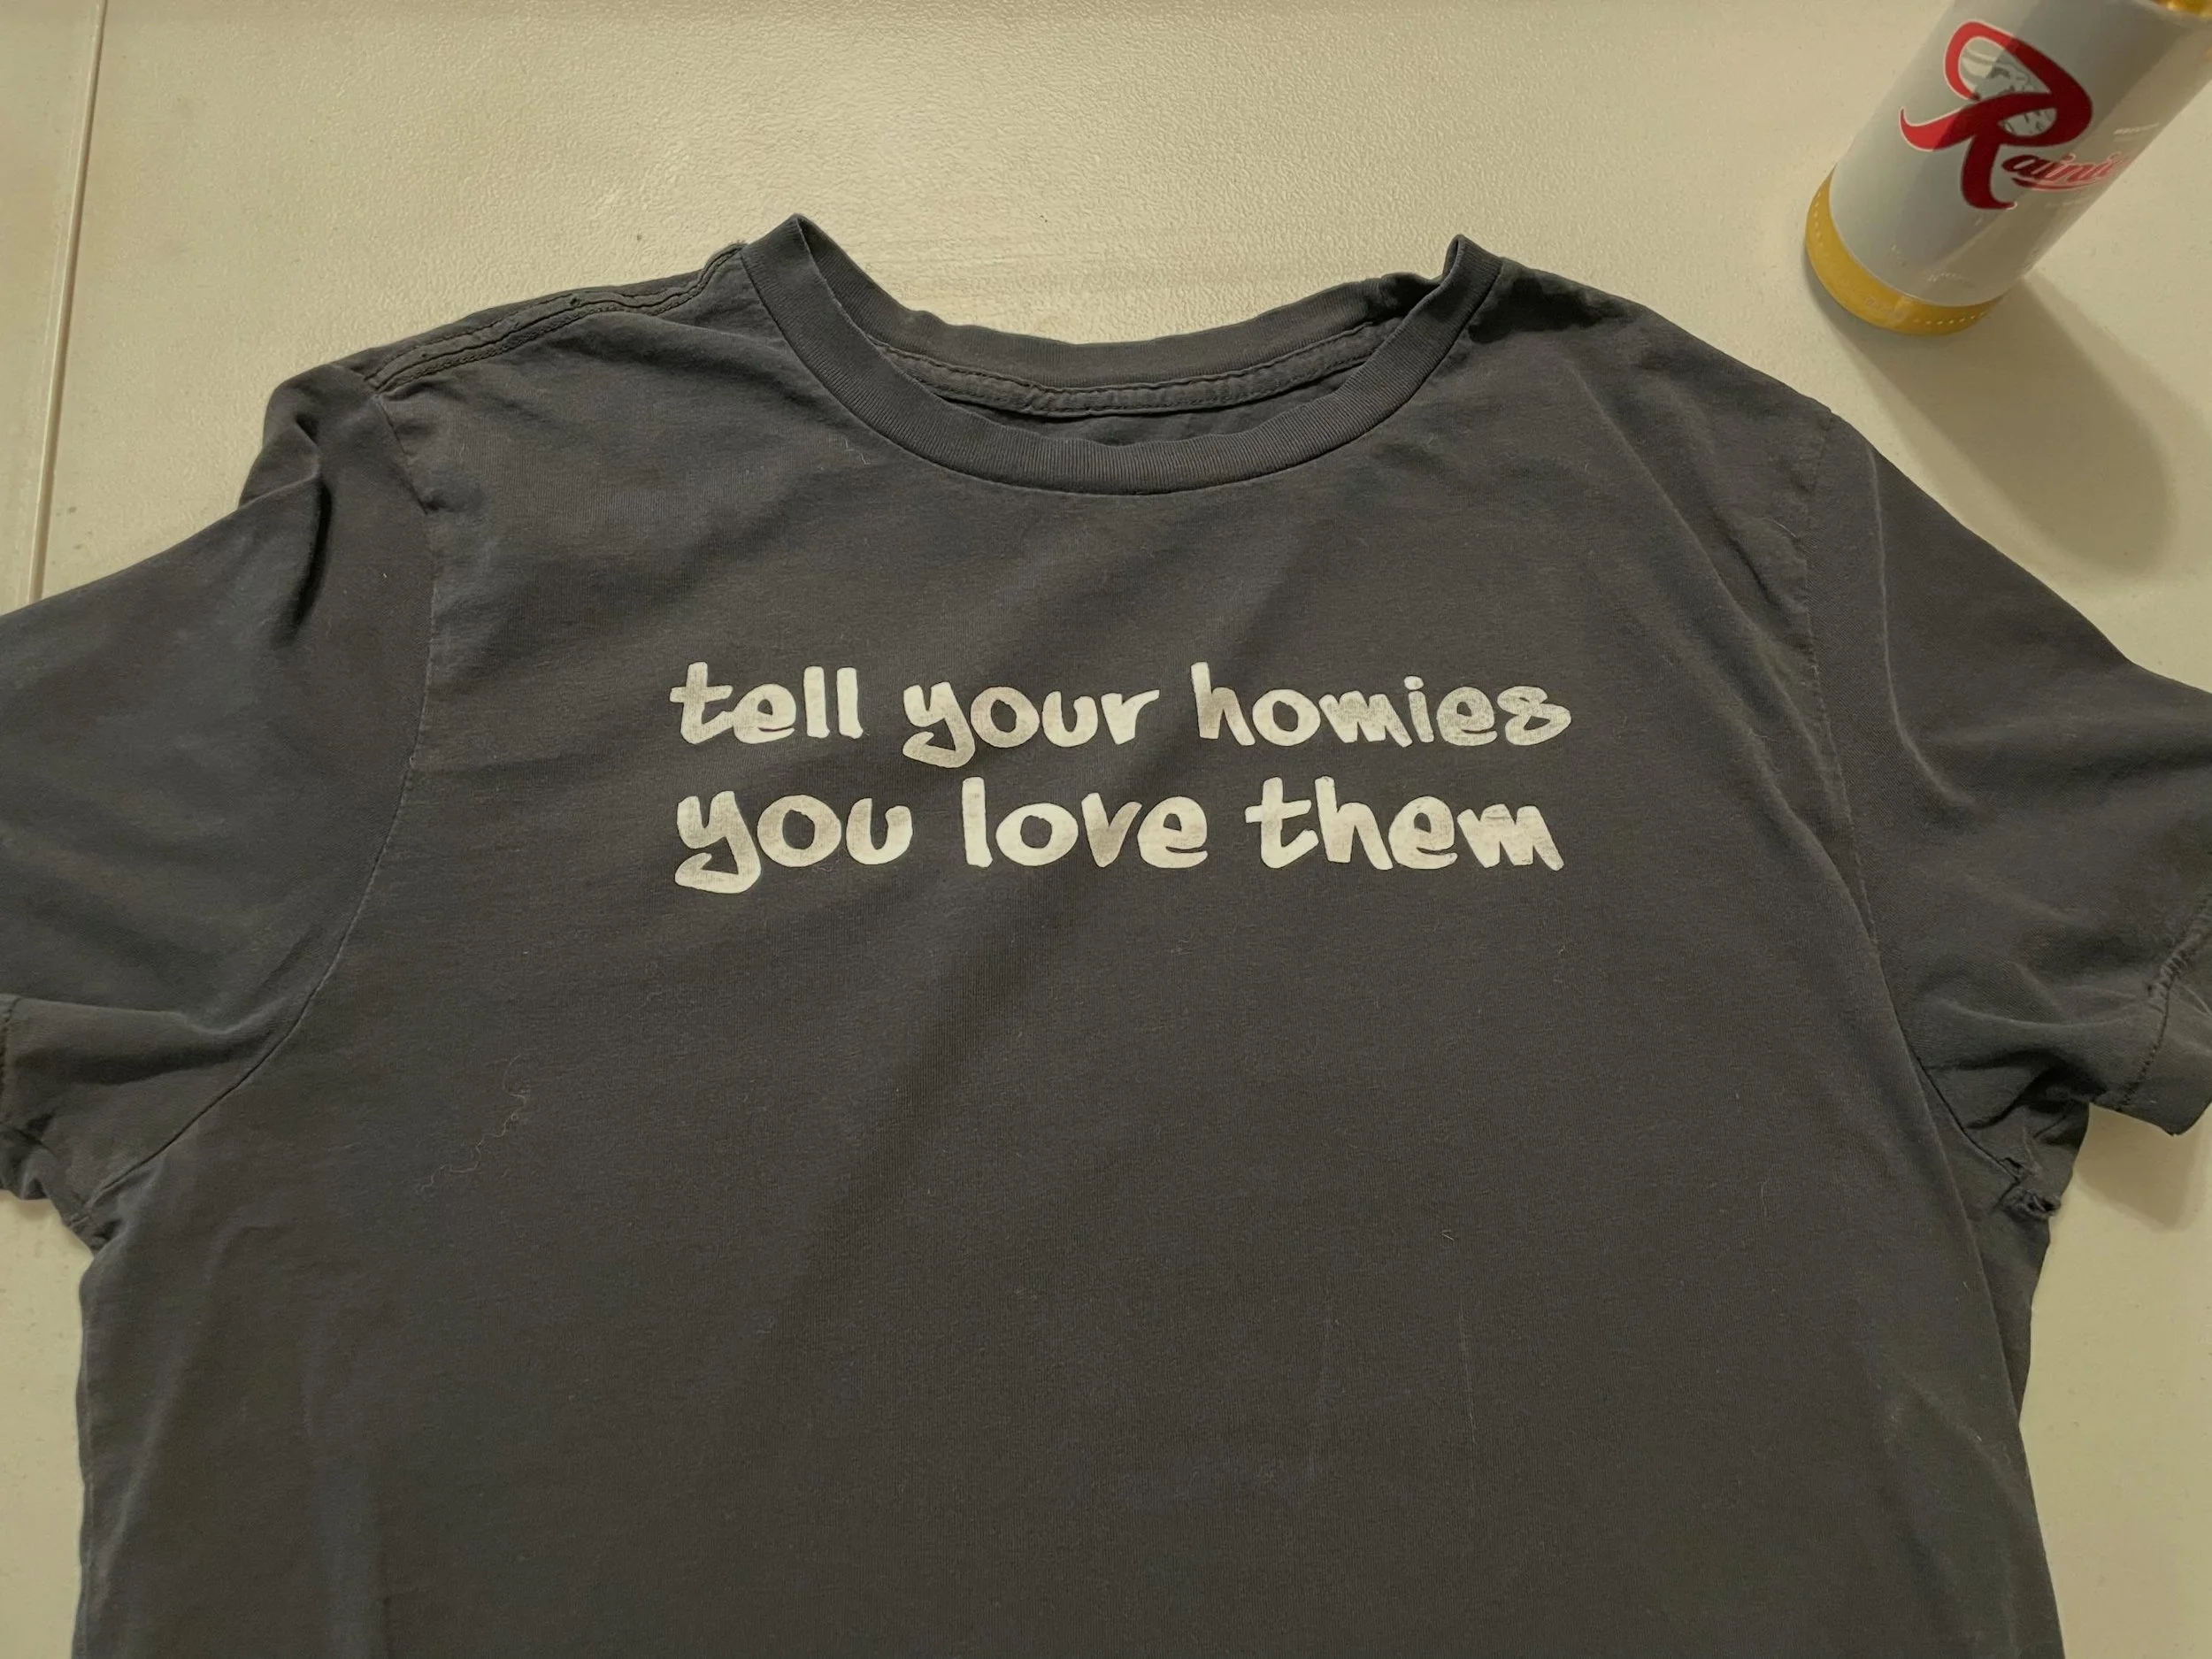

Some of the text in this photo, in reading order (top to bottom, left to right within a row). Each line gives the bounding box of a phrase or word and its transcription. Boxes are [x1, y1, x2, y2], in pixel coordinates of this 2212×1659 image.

[670, 662, 1572, 768] tell your homies
[675, 777, 1564, 894] you love them
